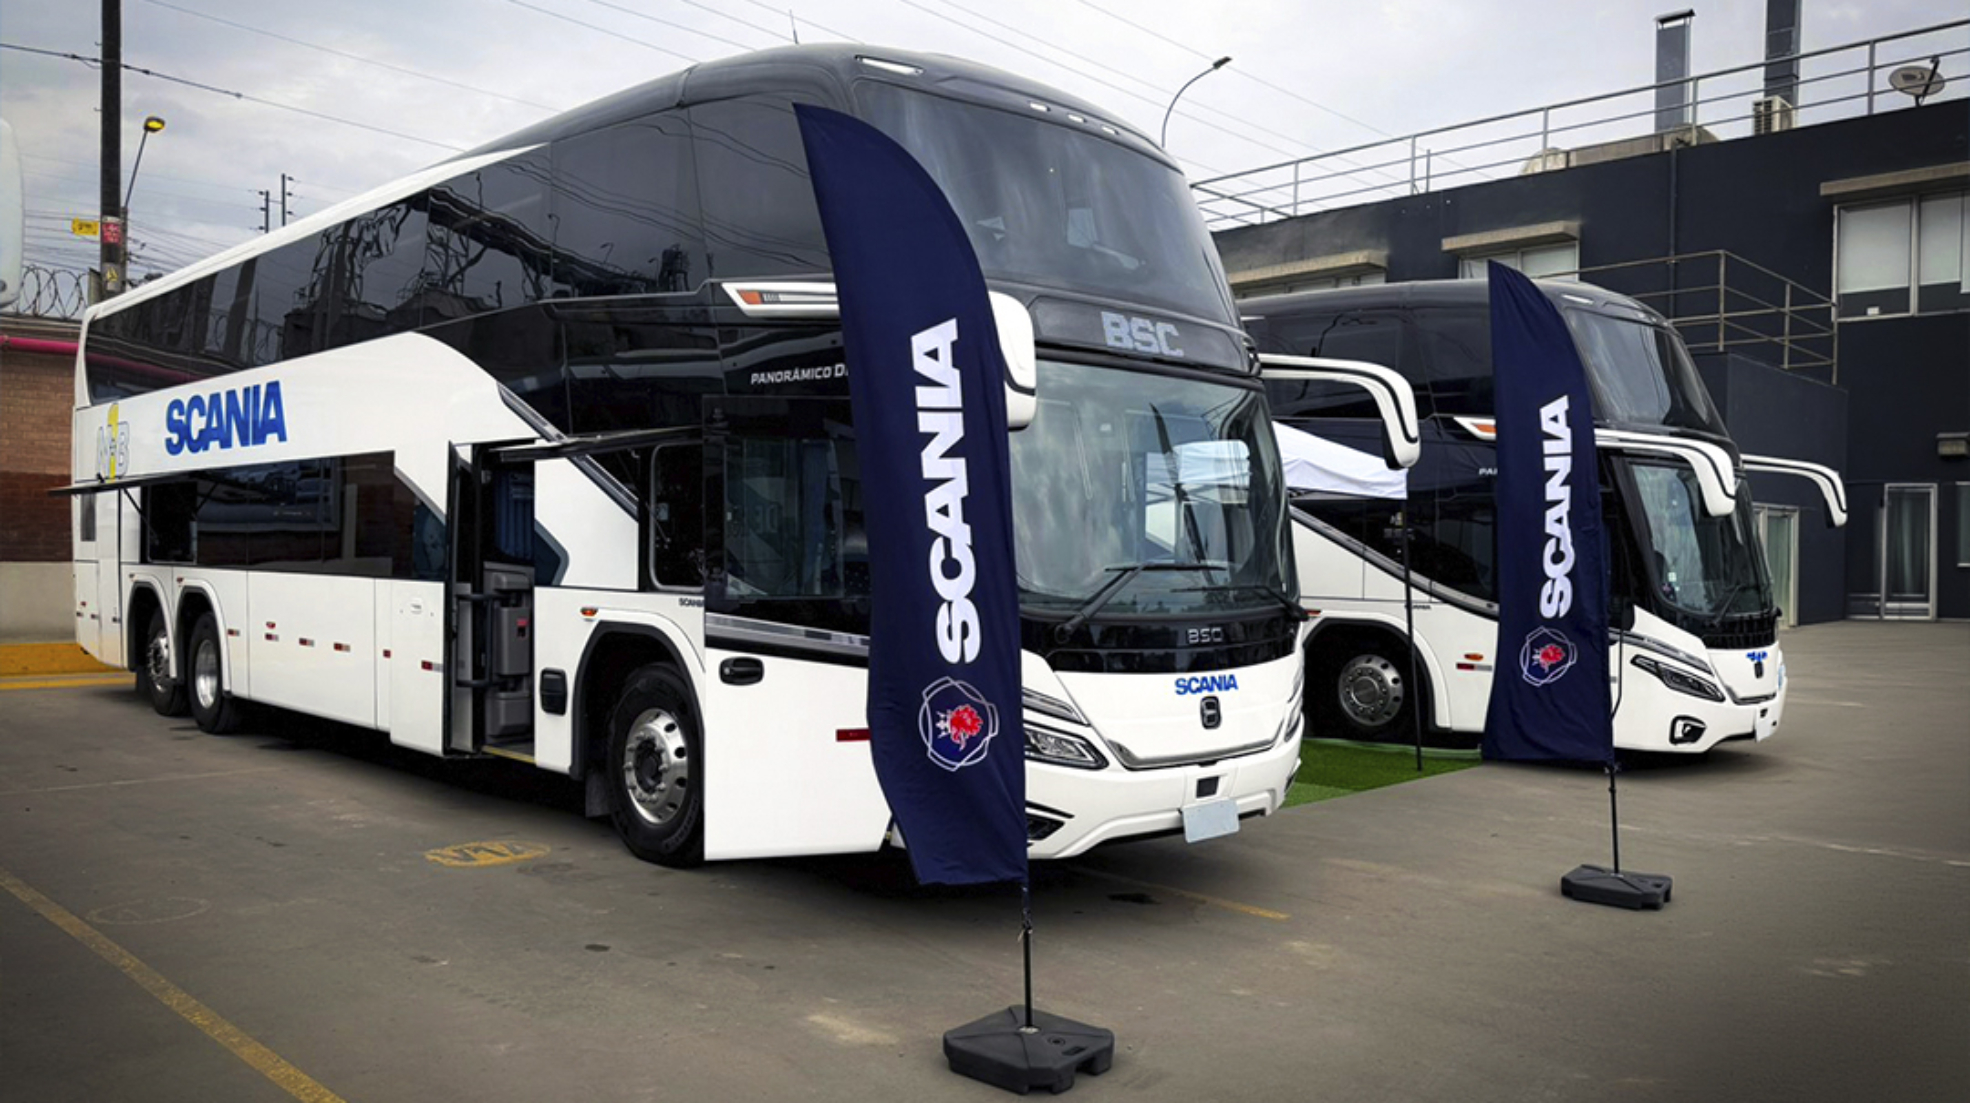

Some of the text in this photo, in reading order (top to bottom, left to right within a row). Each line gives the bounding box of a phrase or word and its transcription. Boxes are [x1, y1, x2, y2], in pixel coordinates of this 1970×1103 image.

[1101, 311, 1184, 357] BSC
[834, 362, 849, 378] D
[165, 380, 287, 456] SCANIA
[911, 318, 981, 664] SCANIA
[1539, 394, 1575, 619] SCANIA
[1187, 627, 1223, 644] BSC
[1174, 674, 1239, 695] SCANIA
